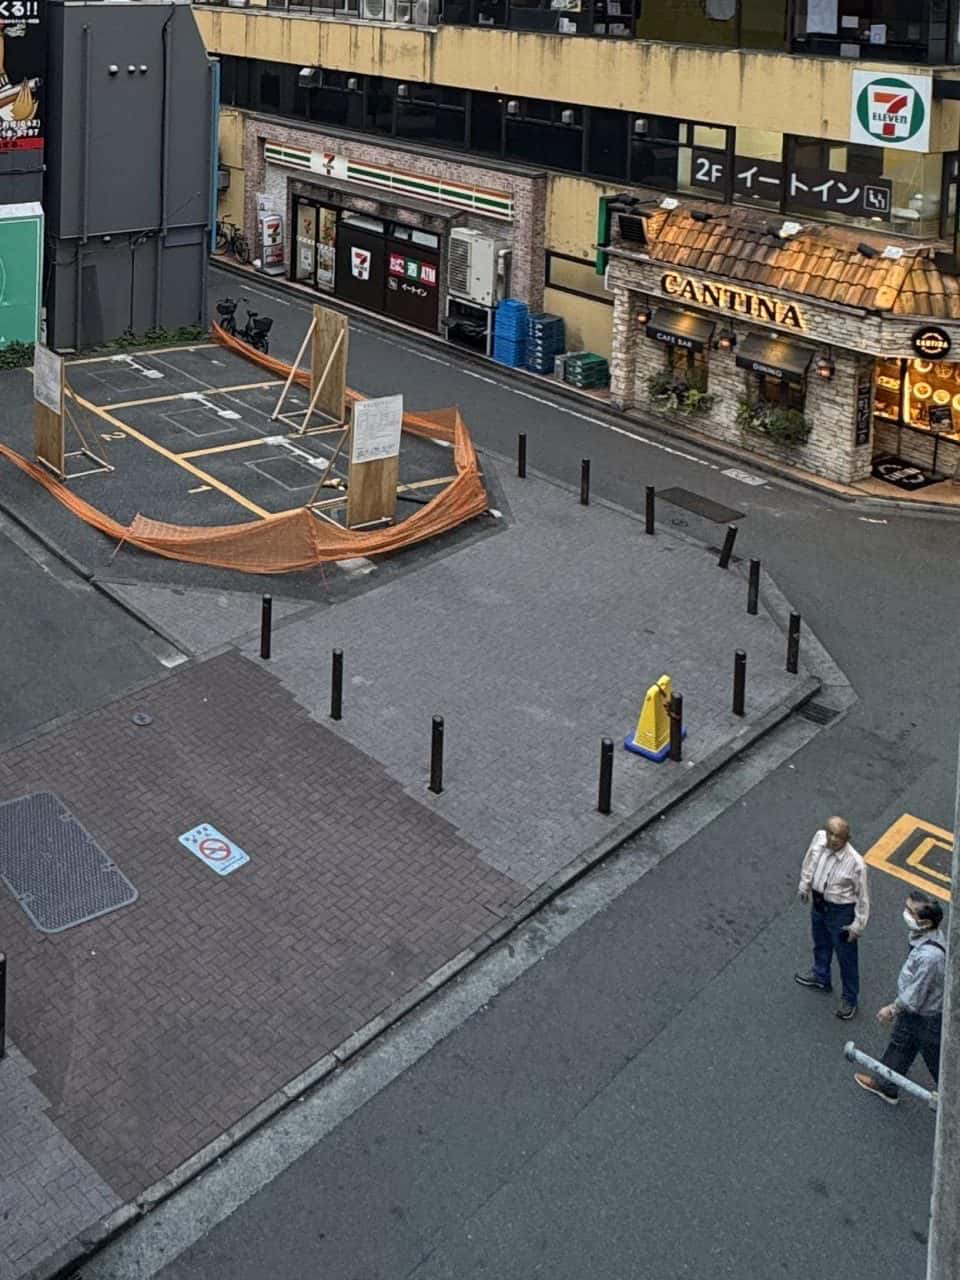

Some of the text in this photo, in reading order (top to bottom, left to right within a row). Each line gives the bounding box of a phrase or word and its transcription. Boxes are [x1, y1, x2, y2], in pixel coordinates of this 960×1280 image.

[695, 158, 860, 205] 2F イートイン
[660, 272, 803, 329] CANTINA
